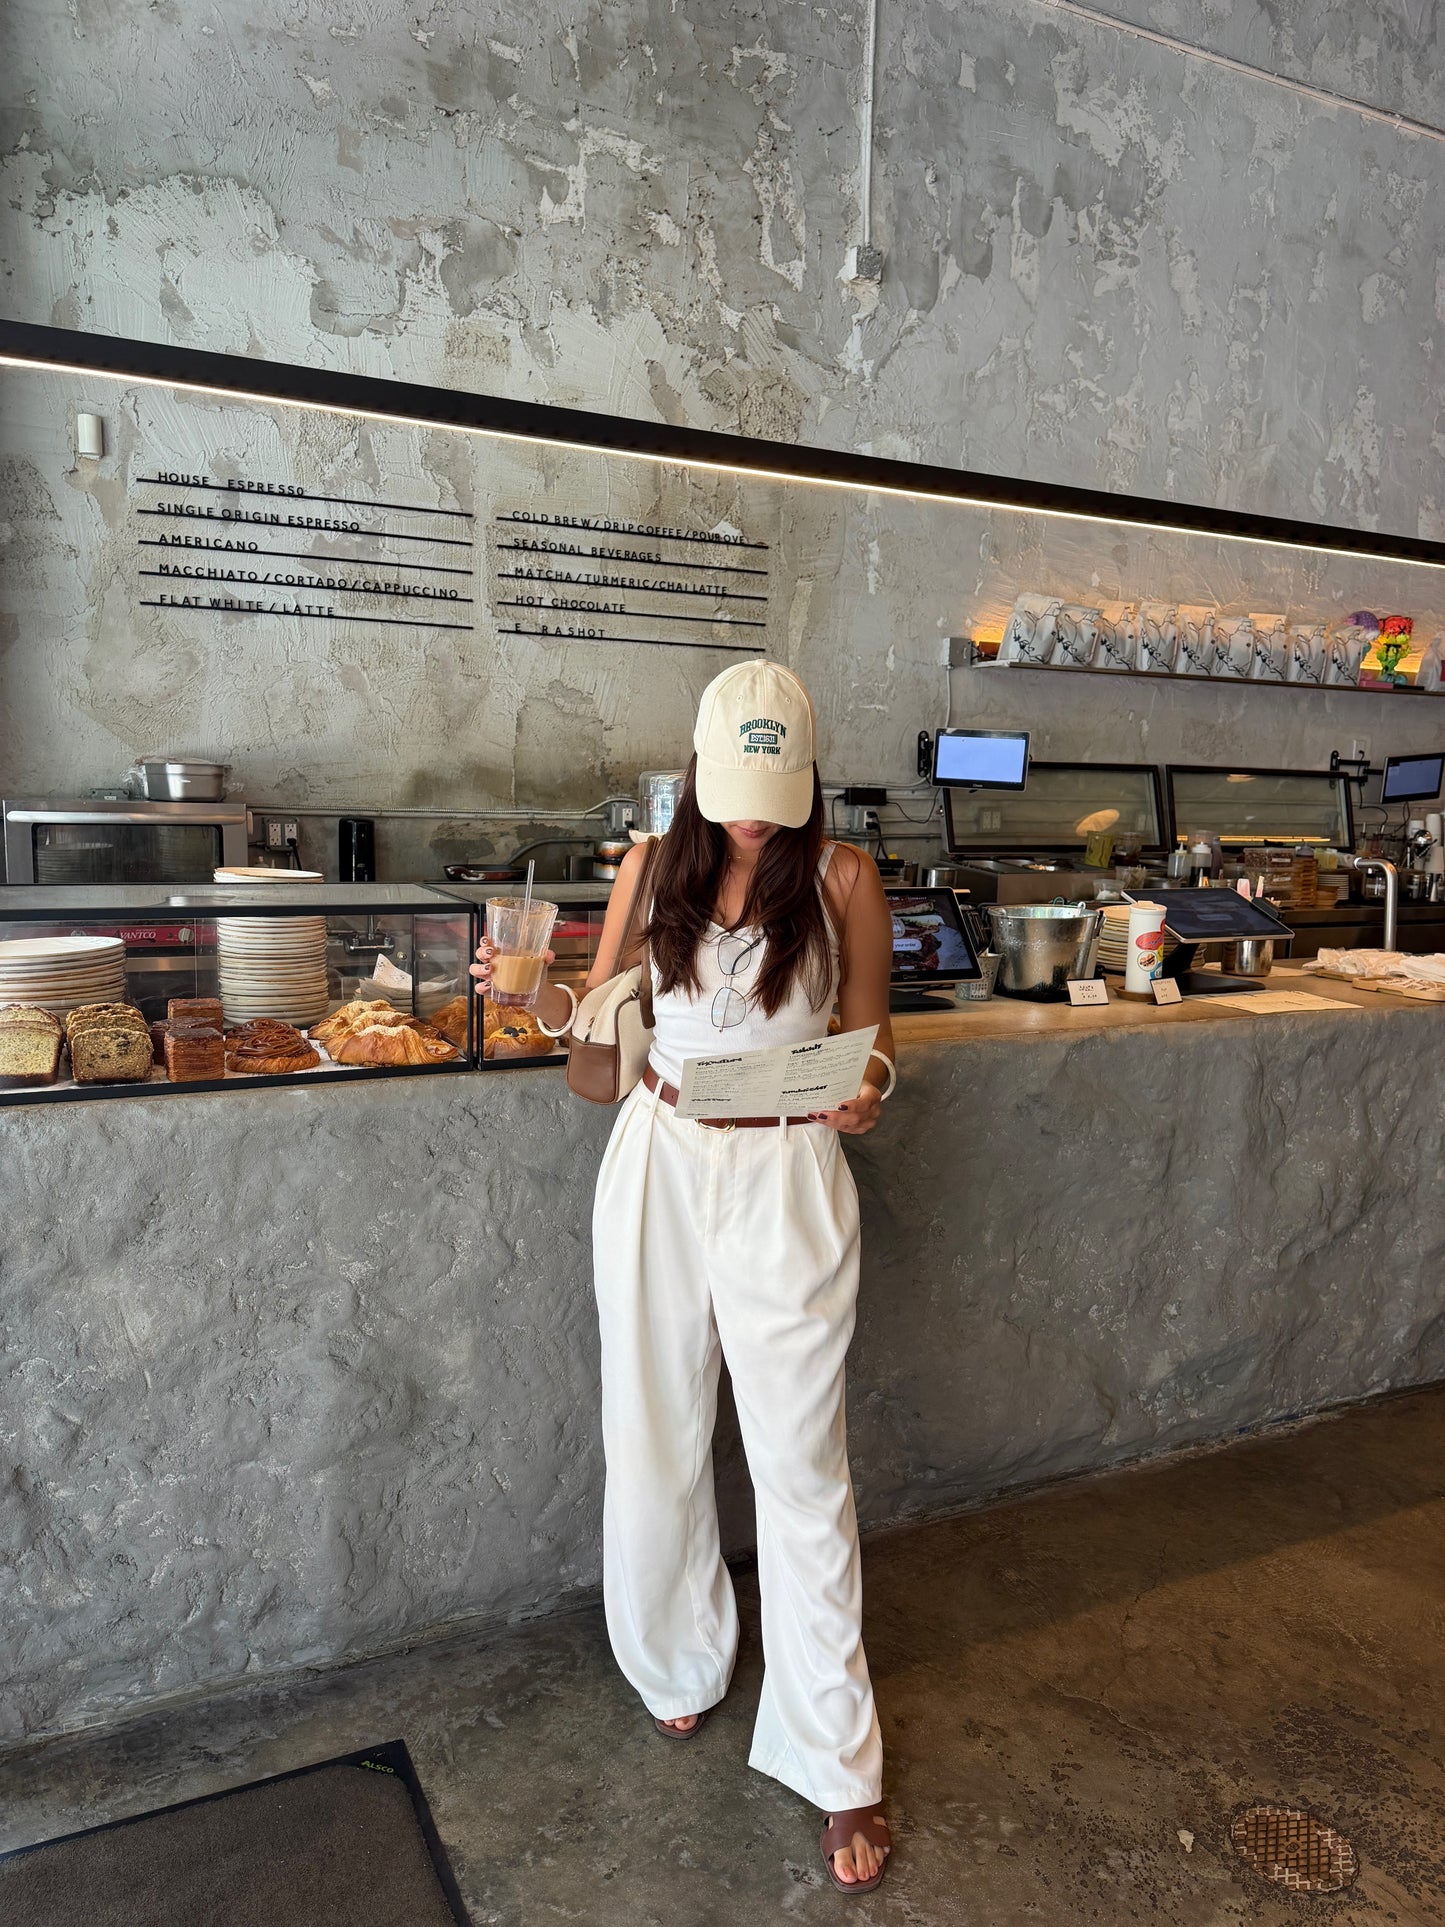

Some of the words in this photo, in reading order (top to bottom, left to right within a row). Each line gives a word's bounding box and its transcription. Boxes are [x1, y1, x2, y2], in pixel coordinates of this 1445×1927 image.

[158, 471, 209, 487] HOUSE
[227, 479, 304, 497] ESPRESSO
[157, 502, 214, 518] SINGLE
[221, 508, 279, 524] ORIGIN
[288, 515, 360, 532] ESPRESSO
[512, 510, 549, 524] COLD
[159, 533, 258, 552] AMERICANO
[513, 538, 583, 555] SEASONAL
[591, 546, 662, 563] BEVERAGES
[159, 594, 201, 608] FLAT
[515, 595, 544, 607] HOT
[551, 598, 626, 613] CHOCOLATE
[739, 718, 787, 738] BROOKLYN
[743, 745, 760, 754] NEW
[761, 745, 781, 755] YORK
[361, 1760, 394, 1773] ALSCO
